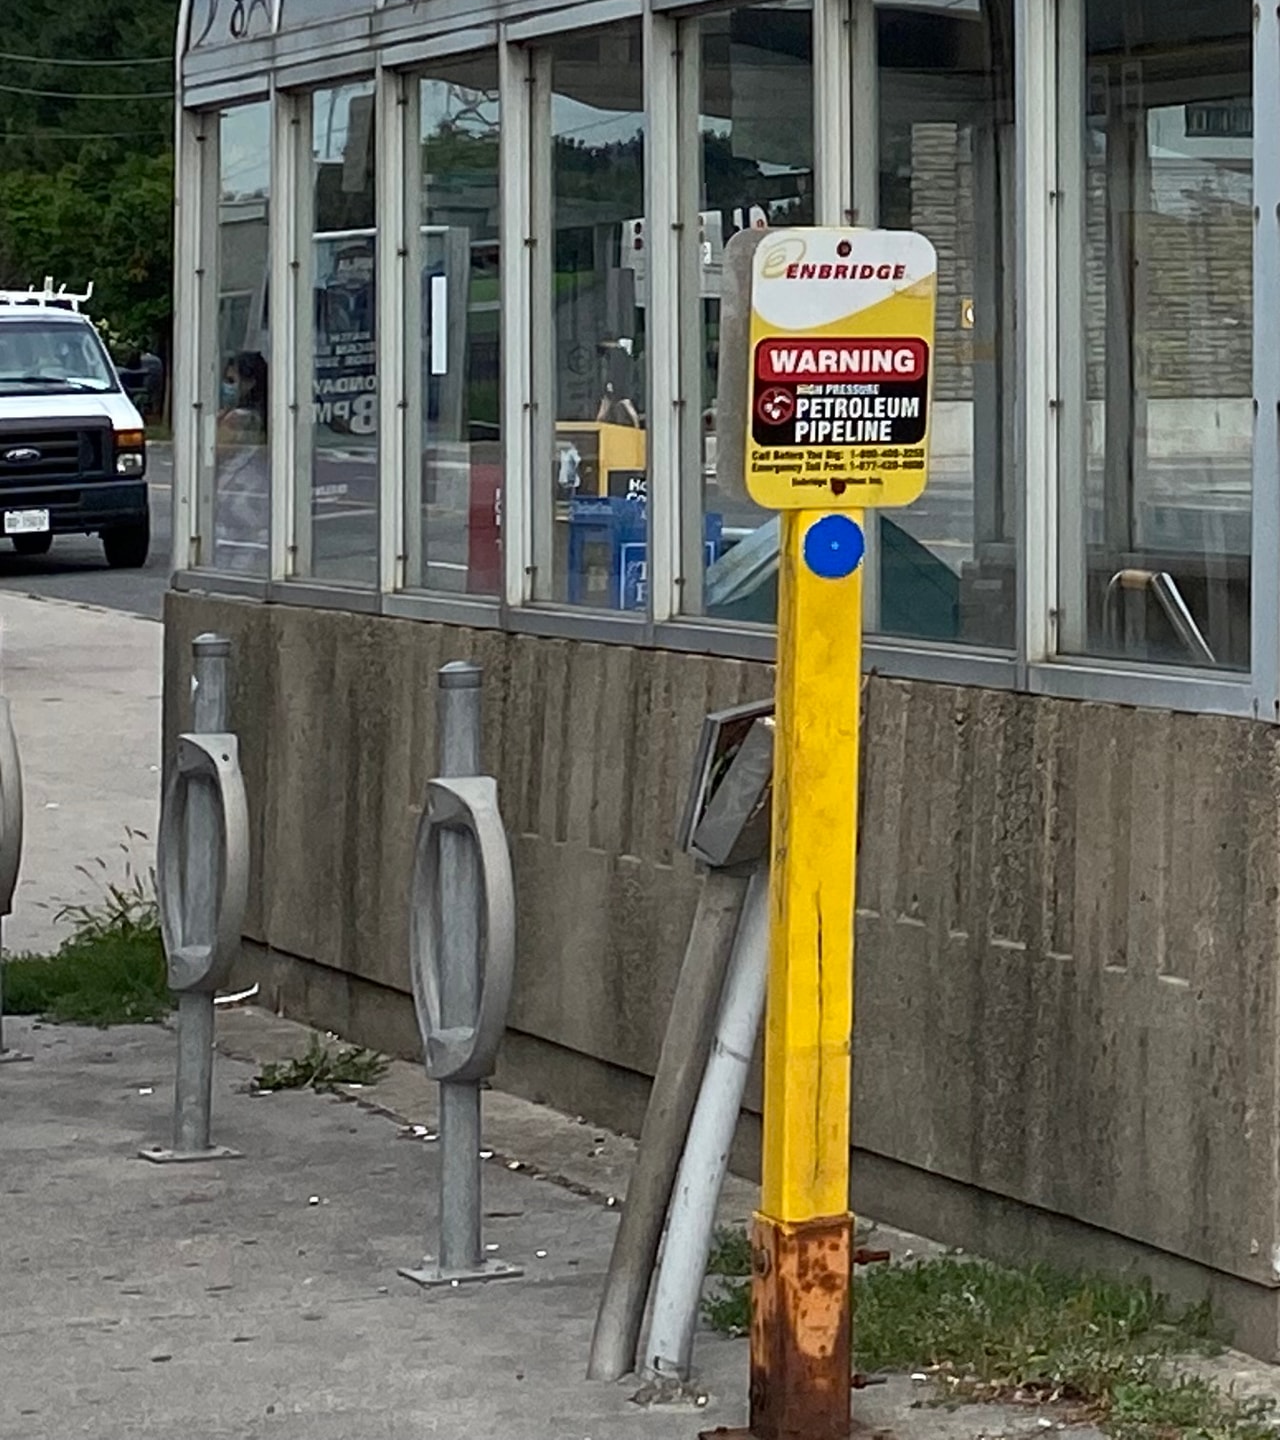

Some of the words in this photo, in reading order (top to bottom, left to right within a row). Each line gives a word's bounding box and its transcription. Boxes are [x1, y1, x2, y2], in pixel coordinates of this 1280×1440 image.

[786, 264, 906, 280] ENBRIDGE
[769, 349, 915, 373] WARNING
[825, 384, 880, 395] PRESSURE
[795, 397, 920, 418] PETROLEUM
[794, 420, 892, 443] PIPELINE
[752, 463, 802, 473] Emergency
